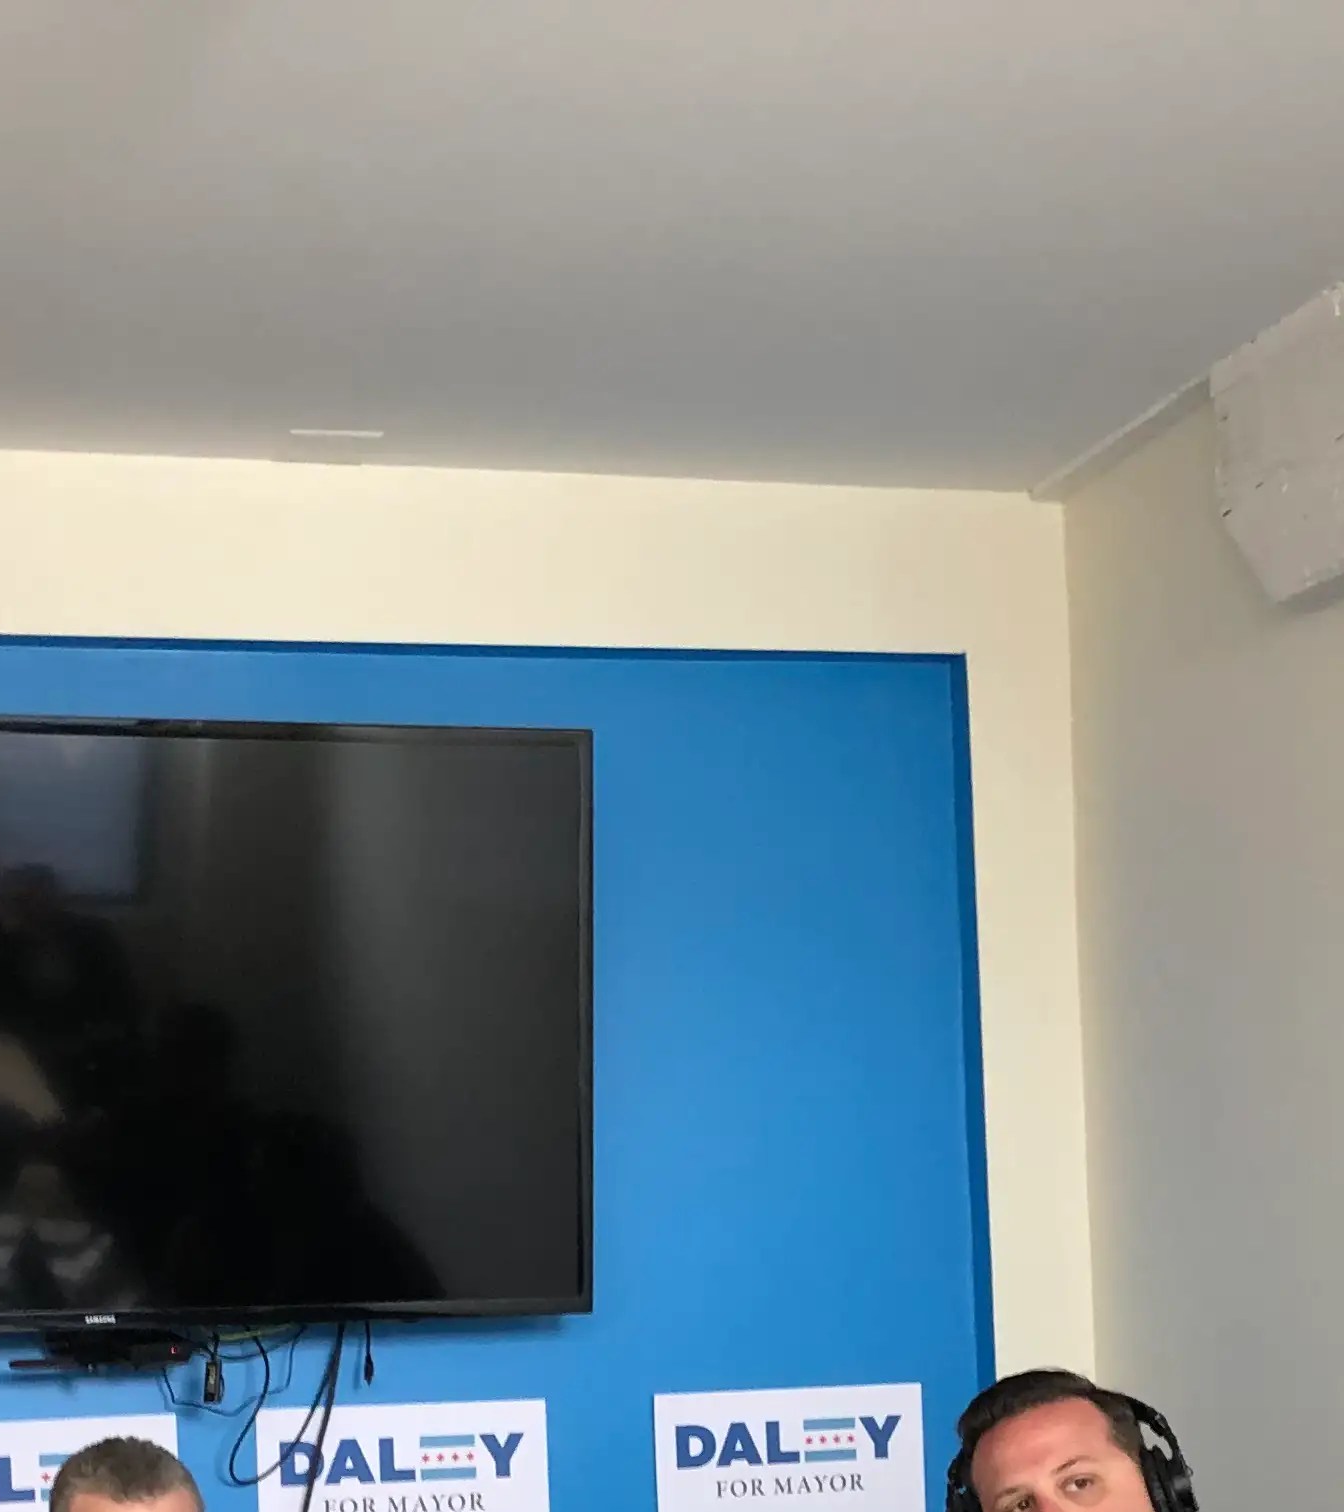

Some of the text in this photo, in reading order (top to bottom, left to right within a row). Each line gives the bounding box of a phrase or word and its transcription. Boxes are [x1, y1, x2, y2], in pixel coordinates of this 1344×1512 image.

[278, 1431, 524, 1487] DALEY
[674, 1414, 902, 1470] DALEY
[716, 1472, 865, 1499] FOR MAYOR
